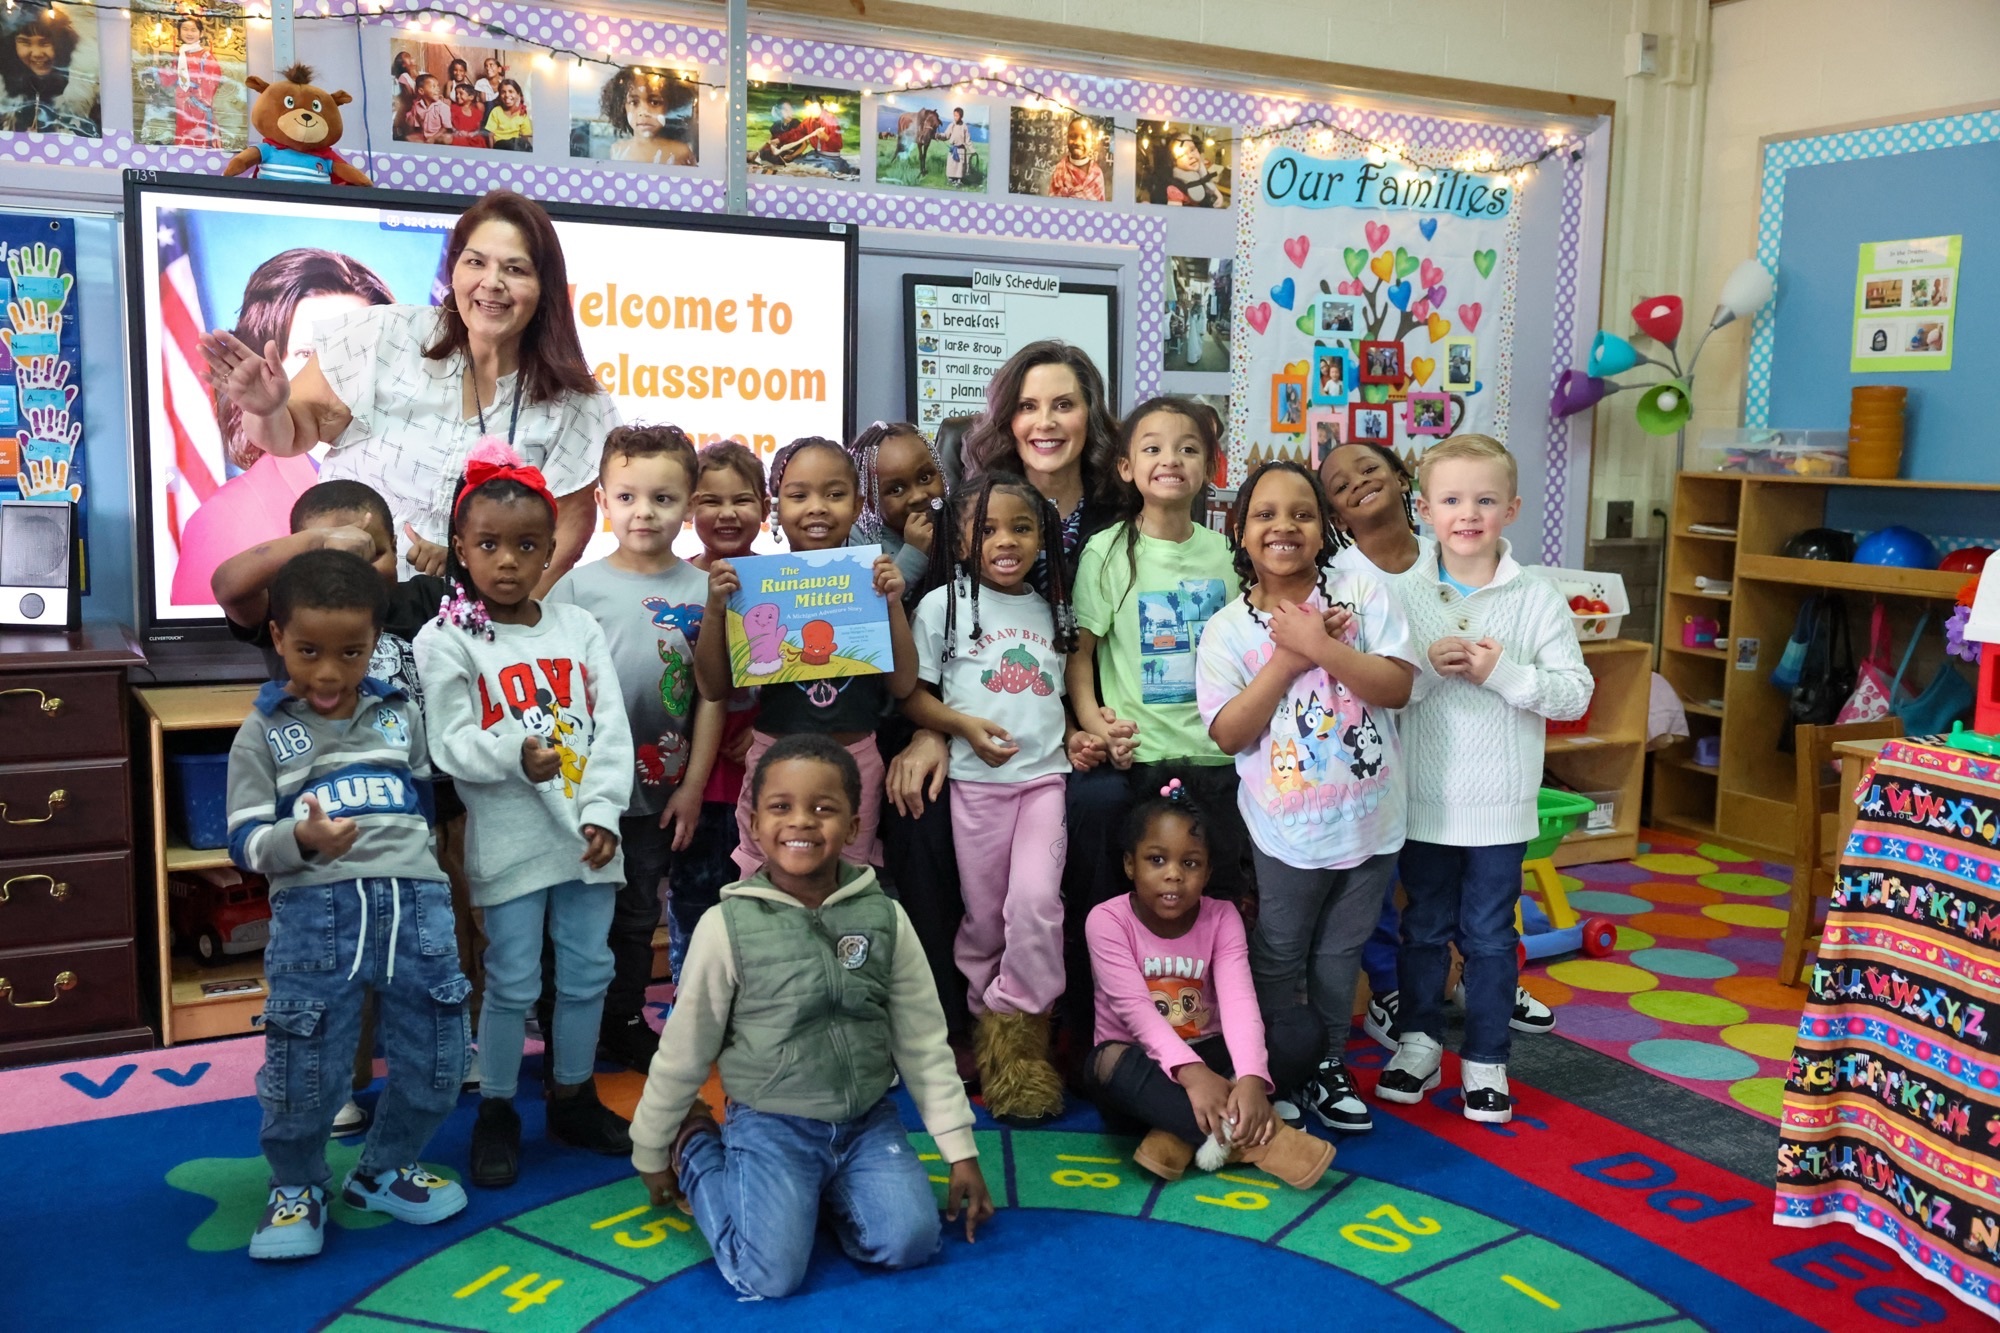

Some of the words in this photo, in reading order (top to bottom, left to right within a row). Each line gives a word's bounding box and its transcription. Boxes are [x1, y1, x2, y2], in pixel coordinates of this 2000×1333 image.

[127, 169, 157, 182] 1739
[1267, 157, 1344, 201] Our
[1356, 161, 1508, 217] Families
[974, 271, 1001, 287] Daily
[1005, 274, 1058, 291] Schedule
[567, 282, 738, 334] elcome
[747, 293, 793, 335] to
[952, 292, 991, 306] arrival
[943, 312, 999, 329] breakfast
[944, 340, 970, 352] large
[972, 342, 1002, 357] group
[593, 352, 826, 402] classroom
[945, 363, 970, 375] small
[972, 364, 998, 376] grou
[951, 383, 985, 400] planni
[780, 566, 800, 576] The
[761, 574, 850, 594] Runaway
[794, 591, 854, 610] Mitten
[267, 721, 315, 763] 18
[1267, 765, 1391, 828] FRIENDS
[1143, 956, 1205, 980] MINI
[1050, 1153, 1122, 1189] 18
[1195, 1172, 1281, 1212] 19
[590, 1205, 692, 1249] 15
[1339, 1204, 1442, 1255] 20
[451, 1265, 564, 1314] 14
